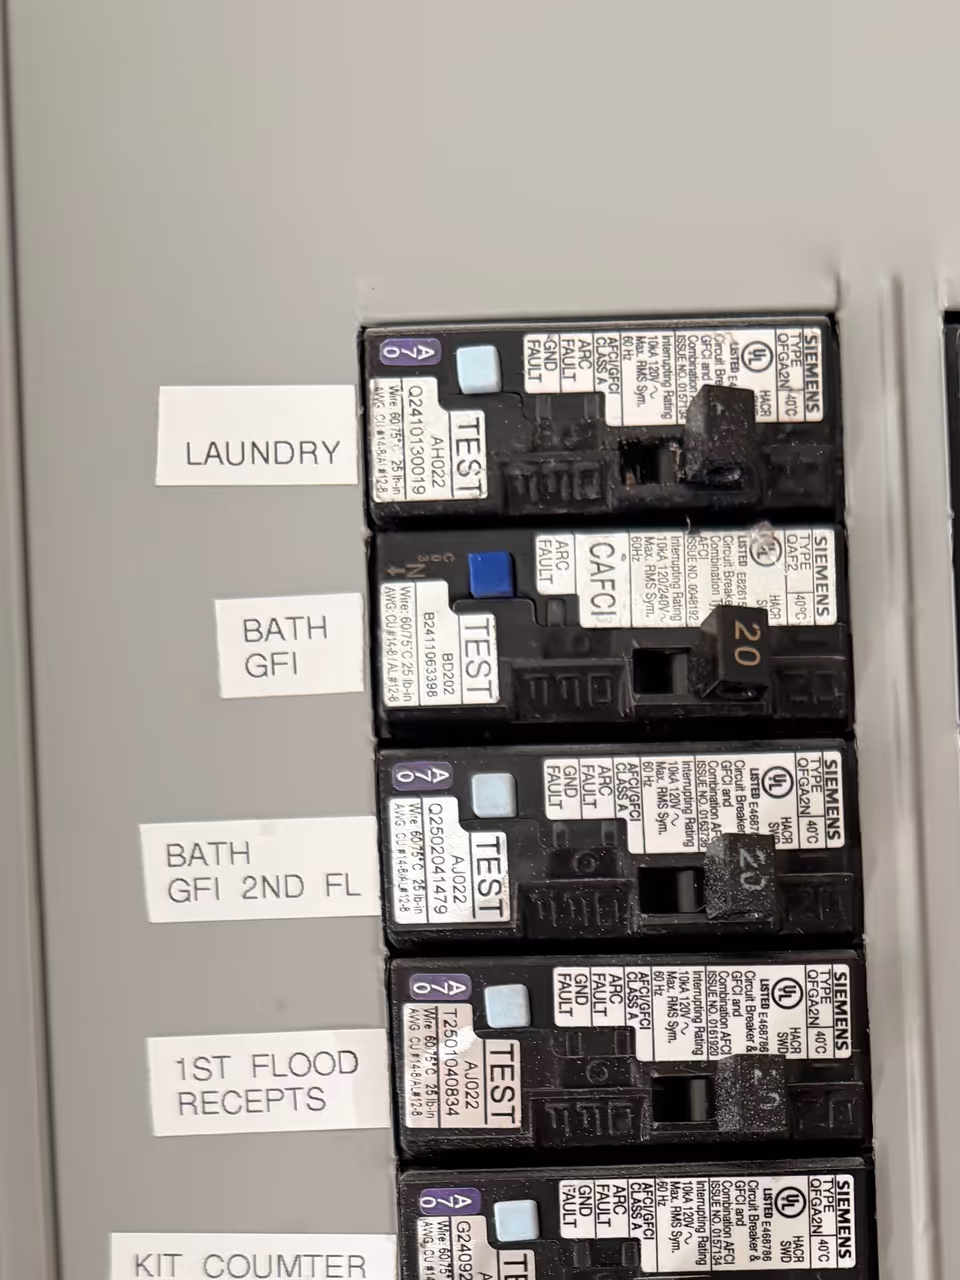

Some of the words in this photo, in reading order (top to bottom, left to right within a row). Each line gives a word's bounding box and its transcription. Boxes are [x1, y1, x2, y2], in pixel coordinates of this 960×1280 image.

[805, 335, 819, 413] SIEMENS
[186, 440, 340, 466] LAUNDRY
[431, 436, 445, 488] AH022
[456, 417, 482, 497] TEST
[589, 542, 616, 616] CAFCI
[814, 536, 829, 617] SIEMENS
[243, 615, 327, 643] BATH
[735, 620, 761, 666] 20
[245, 651, 297, 678] GFI
[442, 653, 454, 695] BD202
[464, 618, 492, 699] TEST
[824, 760, 840, 840] SIEMENS
[166, 841, 250, 867] BATH
[476, 836, 503, 918] TEST
[740, 849, 767, 892] 20
[168, 877, 219, 903] GFI
[242, 873, 304, 899] 2ND
[326, 872, 361, 896] FL
[451, 855, 466, 904] AJ022
[834, 972, 849, 1050] SIEMENS
[175, 1055, 231, 1081] 1ST
[252, 1050, 358, 1077] FLOOD
[464, 1060, 479, 1109] AJ022
[490, 1043, 515, 1124] TEST
[177, 1086, 326, 1115] RECEPTS
[837, 1180, 852, 1259] SIEMENS
[135, 1253, 183, 1278] KIT
[203, 1253, 367, 1279] COUMTER
